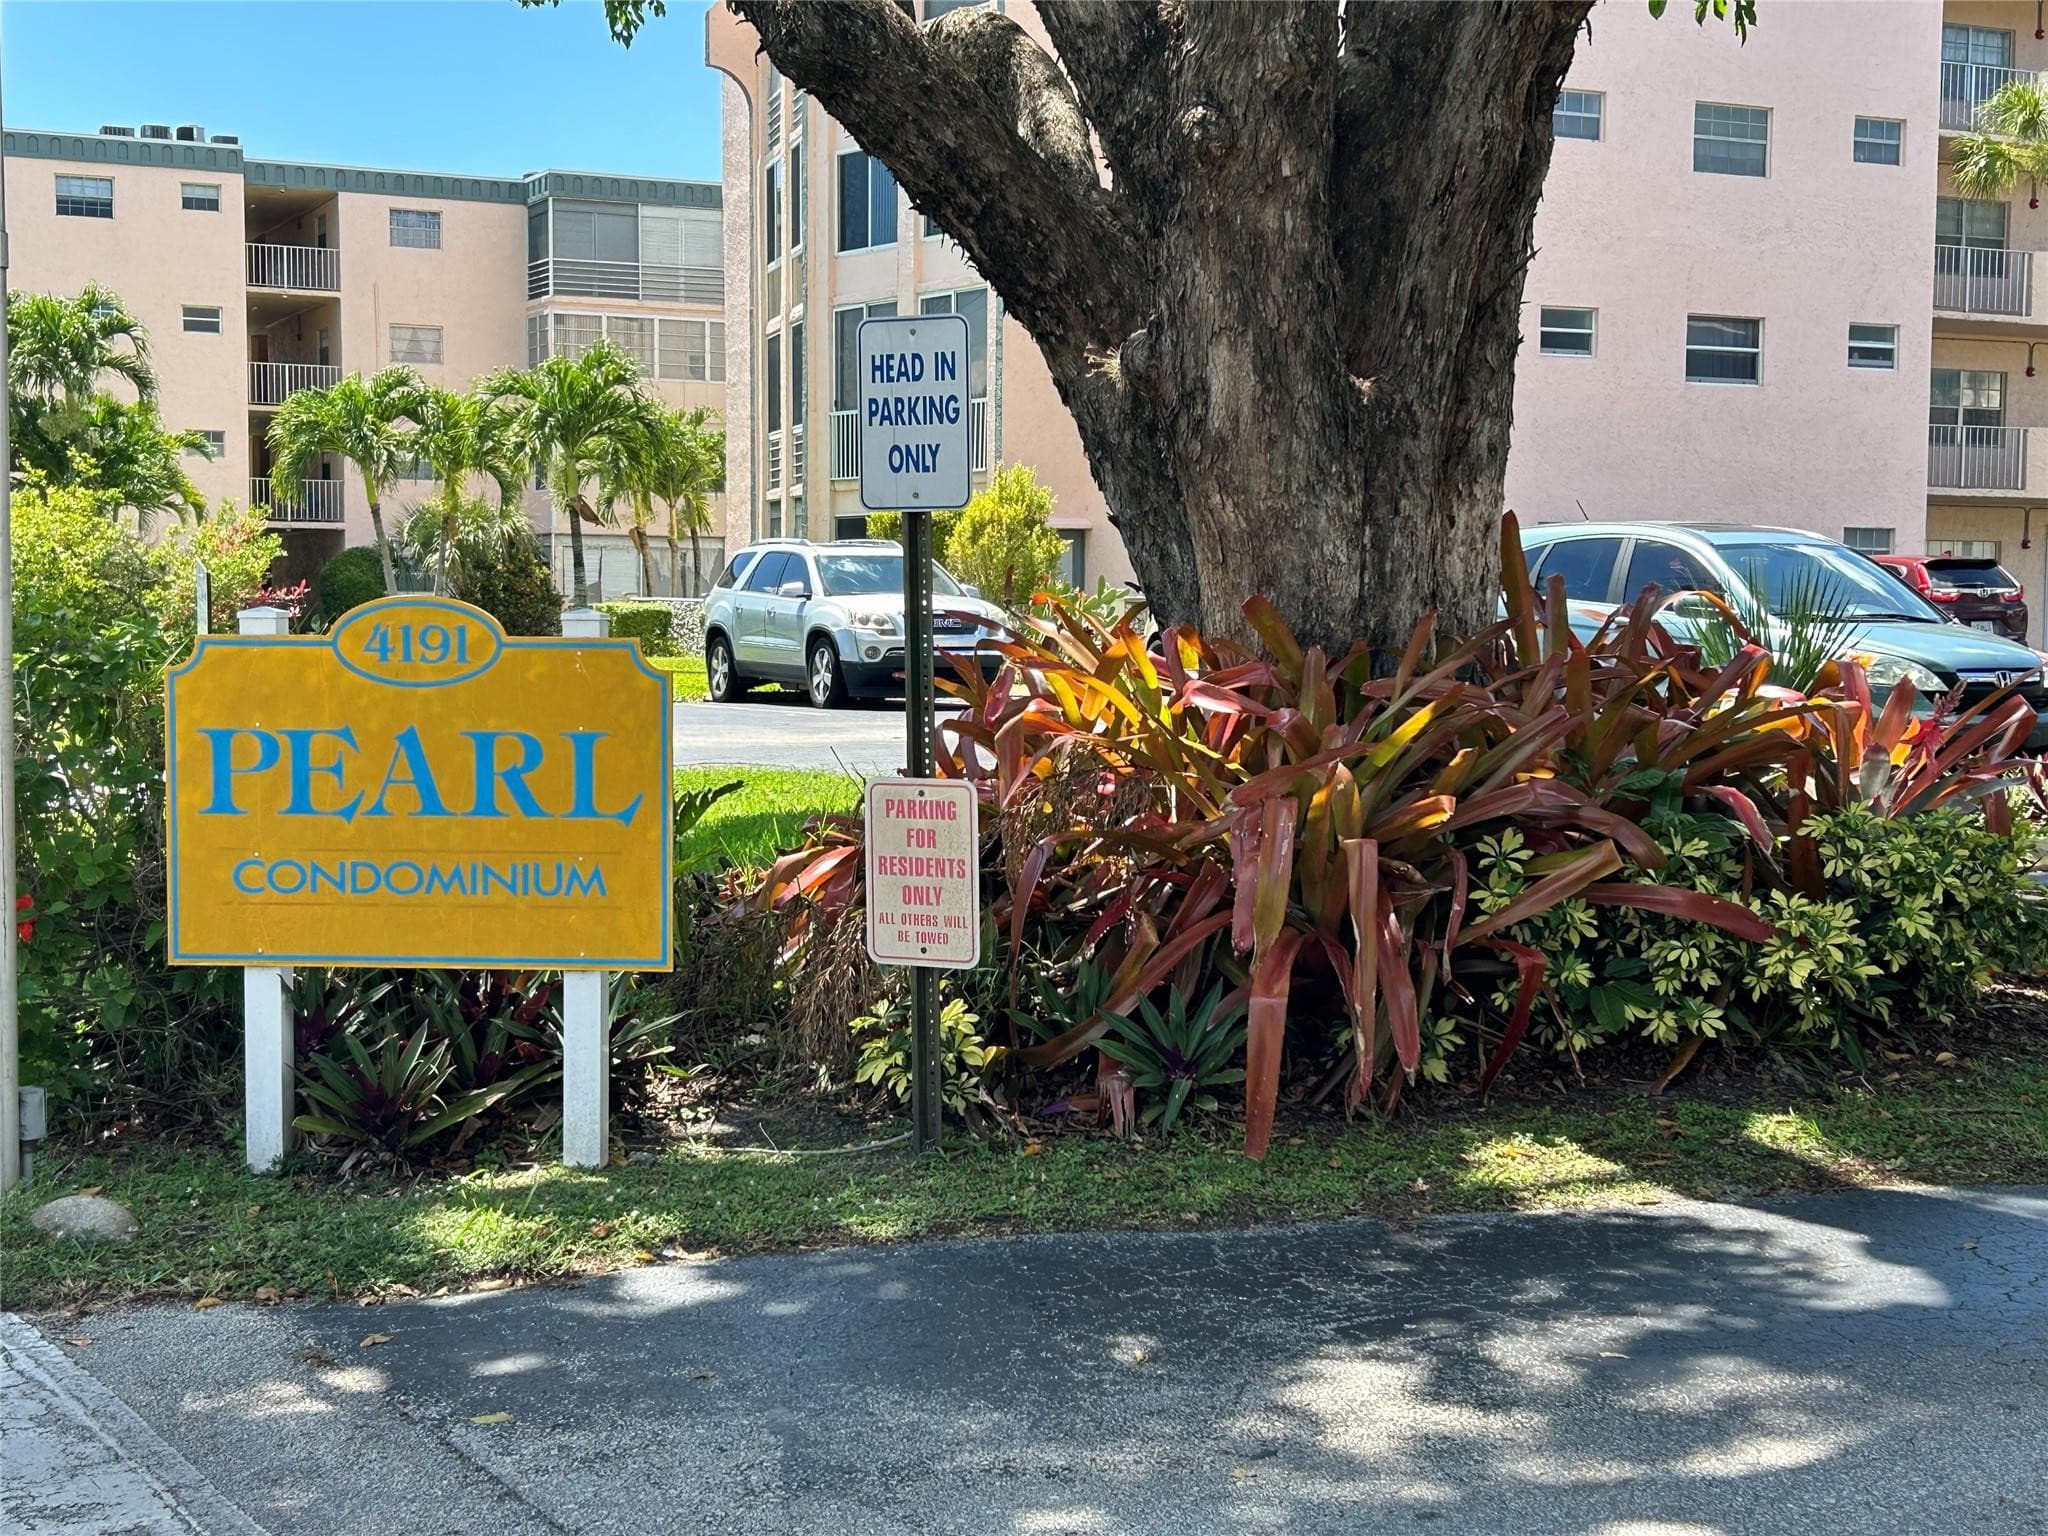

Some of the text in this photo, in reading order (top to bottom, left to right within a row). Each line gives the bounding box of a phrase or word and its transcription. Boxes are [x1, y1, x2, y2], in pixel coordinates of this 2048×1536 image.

[871, 351, 956, 383] HEAD IN
[868, 394, 960, 426] PARKING
[888, 443, 941, 474] ONLY
[363, 623, 470, 665] 4191
[198, 724, 643, 828] PEARL
[885, 799, 957, 821] PARKING
[906, 828, 937, 849] FOR
[232, 858, 607, 897] CONDOMINIUM
[878, 856, 966, 879] RESIDENTS
[902, 885, 943, 906] ONLY
[879, 912, 968, 929] ALL OTHERS WILL
[898, 930, 949, 945] BE TOWED
